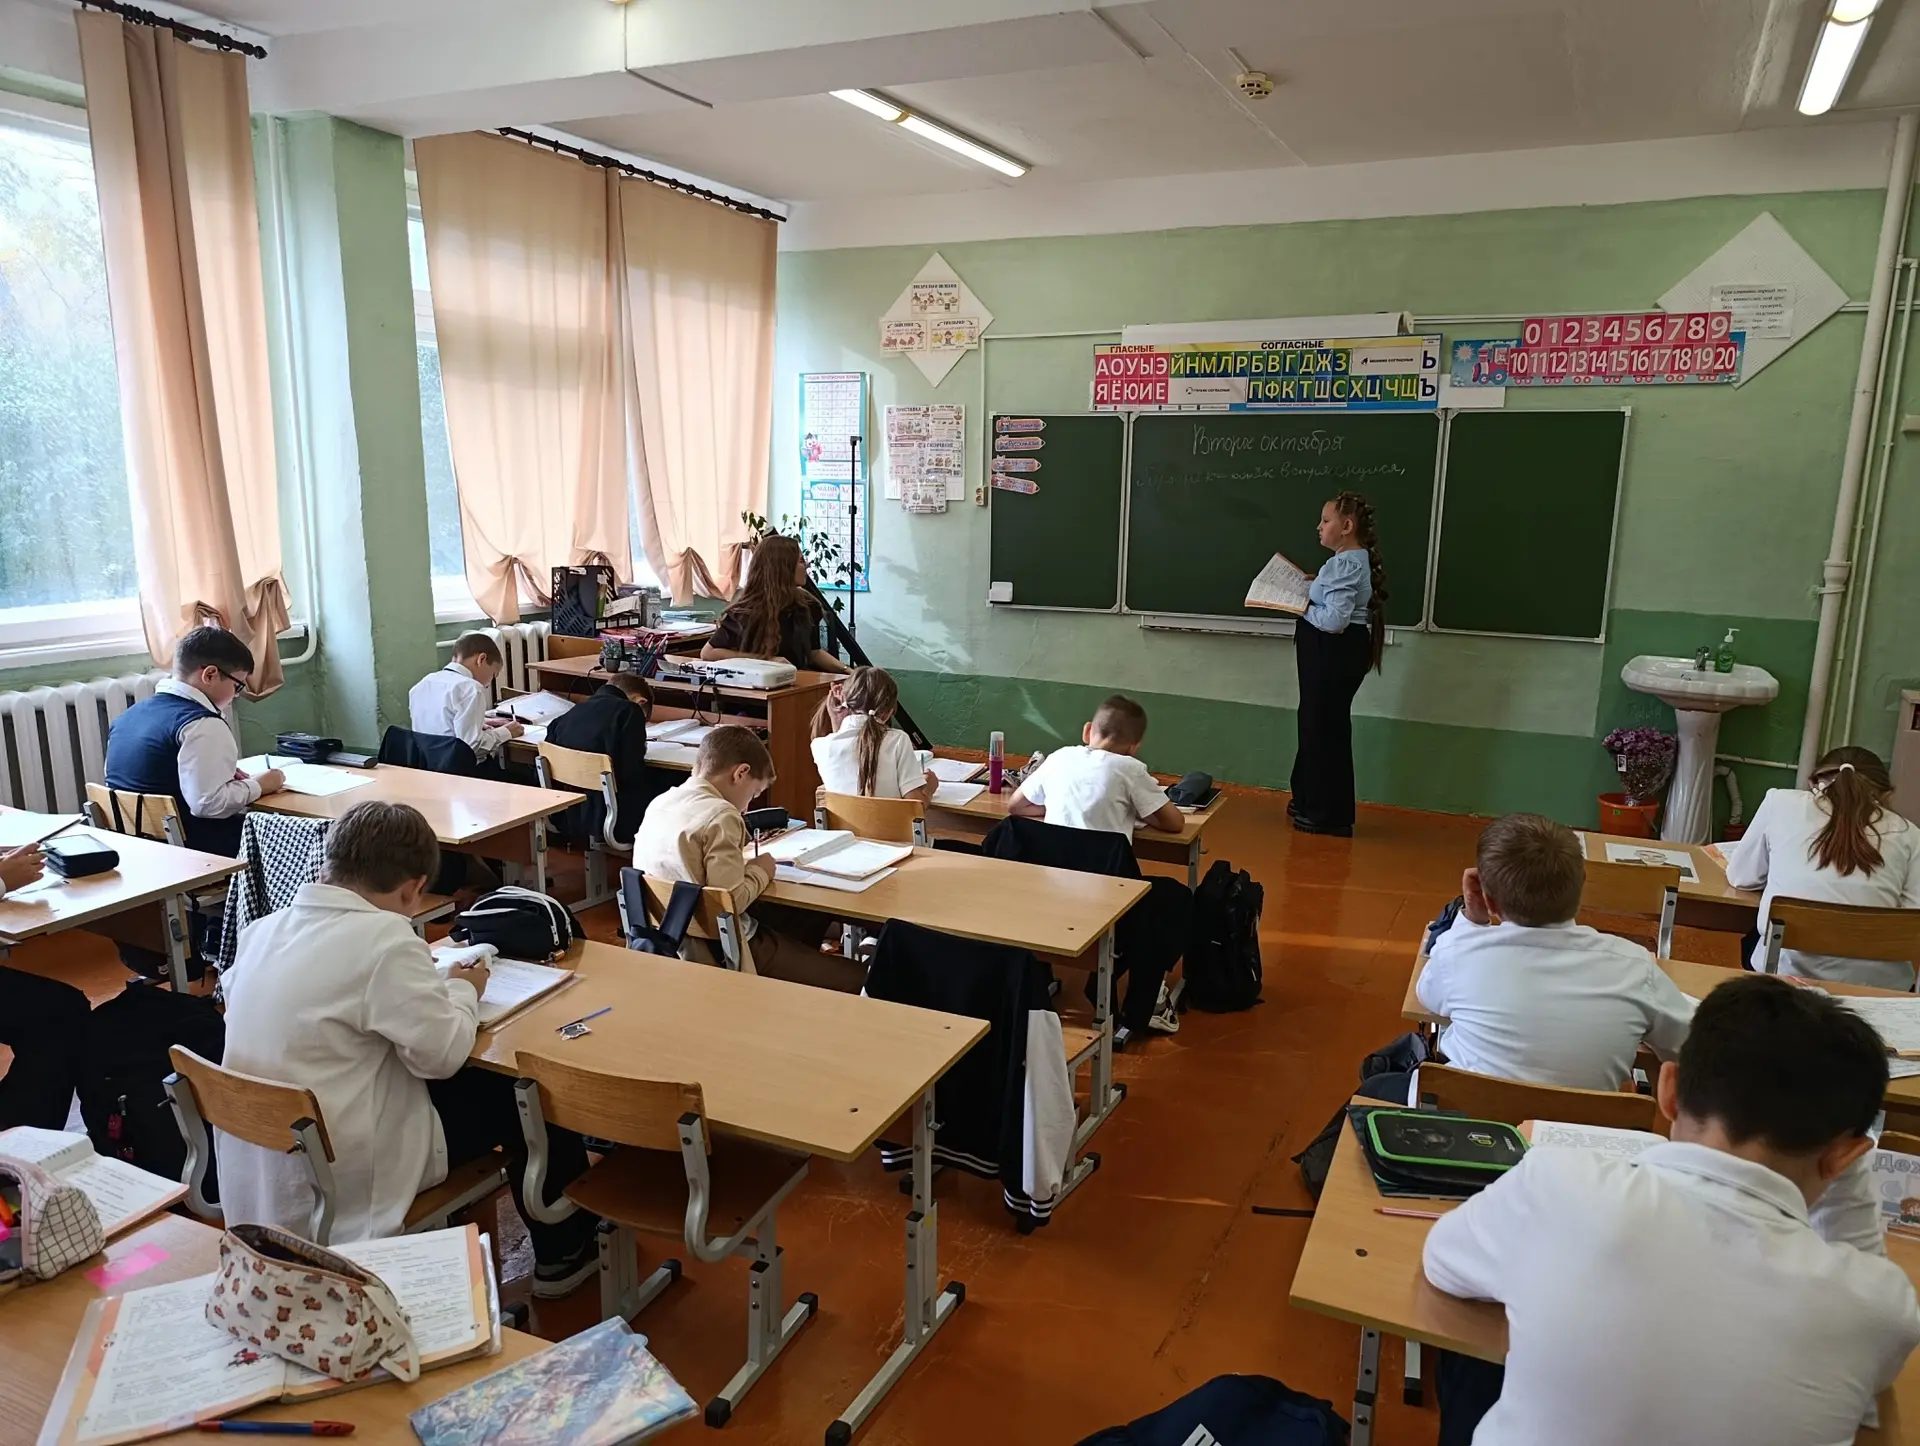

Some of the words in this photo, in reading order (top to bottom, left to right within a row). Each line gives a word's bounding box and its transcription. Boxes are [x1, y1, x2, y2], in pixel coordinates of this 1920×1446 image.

[1525, 322, 1541, 343] 0
[1548, 322, 1557, 343] 1
[1564, 321, 1579, 342] 2
[1584, 321, 1600, 342] 3
[1604, 320, 1621, 341] 4
[1625, 320, 1641, 341] 5
[1646, 319, 1662, 340] 6
[1668, 318, 1684, 340] 7
[1688, 317, 1705, 339] 8
[1711, 316, 1728, 338] 9
[1110, 345, 1155, 353] ГЛАСНЫЕ
[1261, 340, 1324, 350] СОГЛАСНЫЕ
[1511, 352, 1527, 374] 10
[1531, 352, 1547, 374] 11
[1550, 351, 1567, 373] 12
[1570, 351, 1587, 373] 13
[1590, 350, 1607, 372] 14
[1611, 350, 1628, 372] 15
[1631, 349, 1649, 371] 16
[1652, 349, 1670, 371] 17
[1672, 348, 1690, 370] 18
[1693, 348, 1712, 370] 19
[1714, 347, 1735, 369] 20
[1260, 429, 1346, 456] октября
